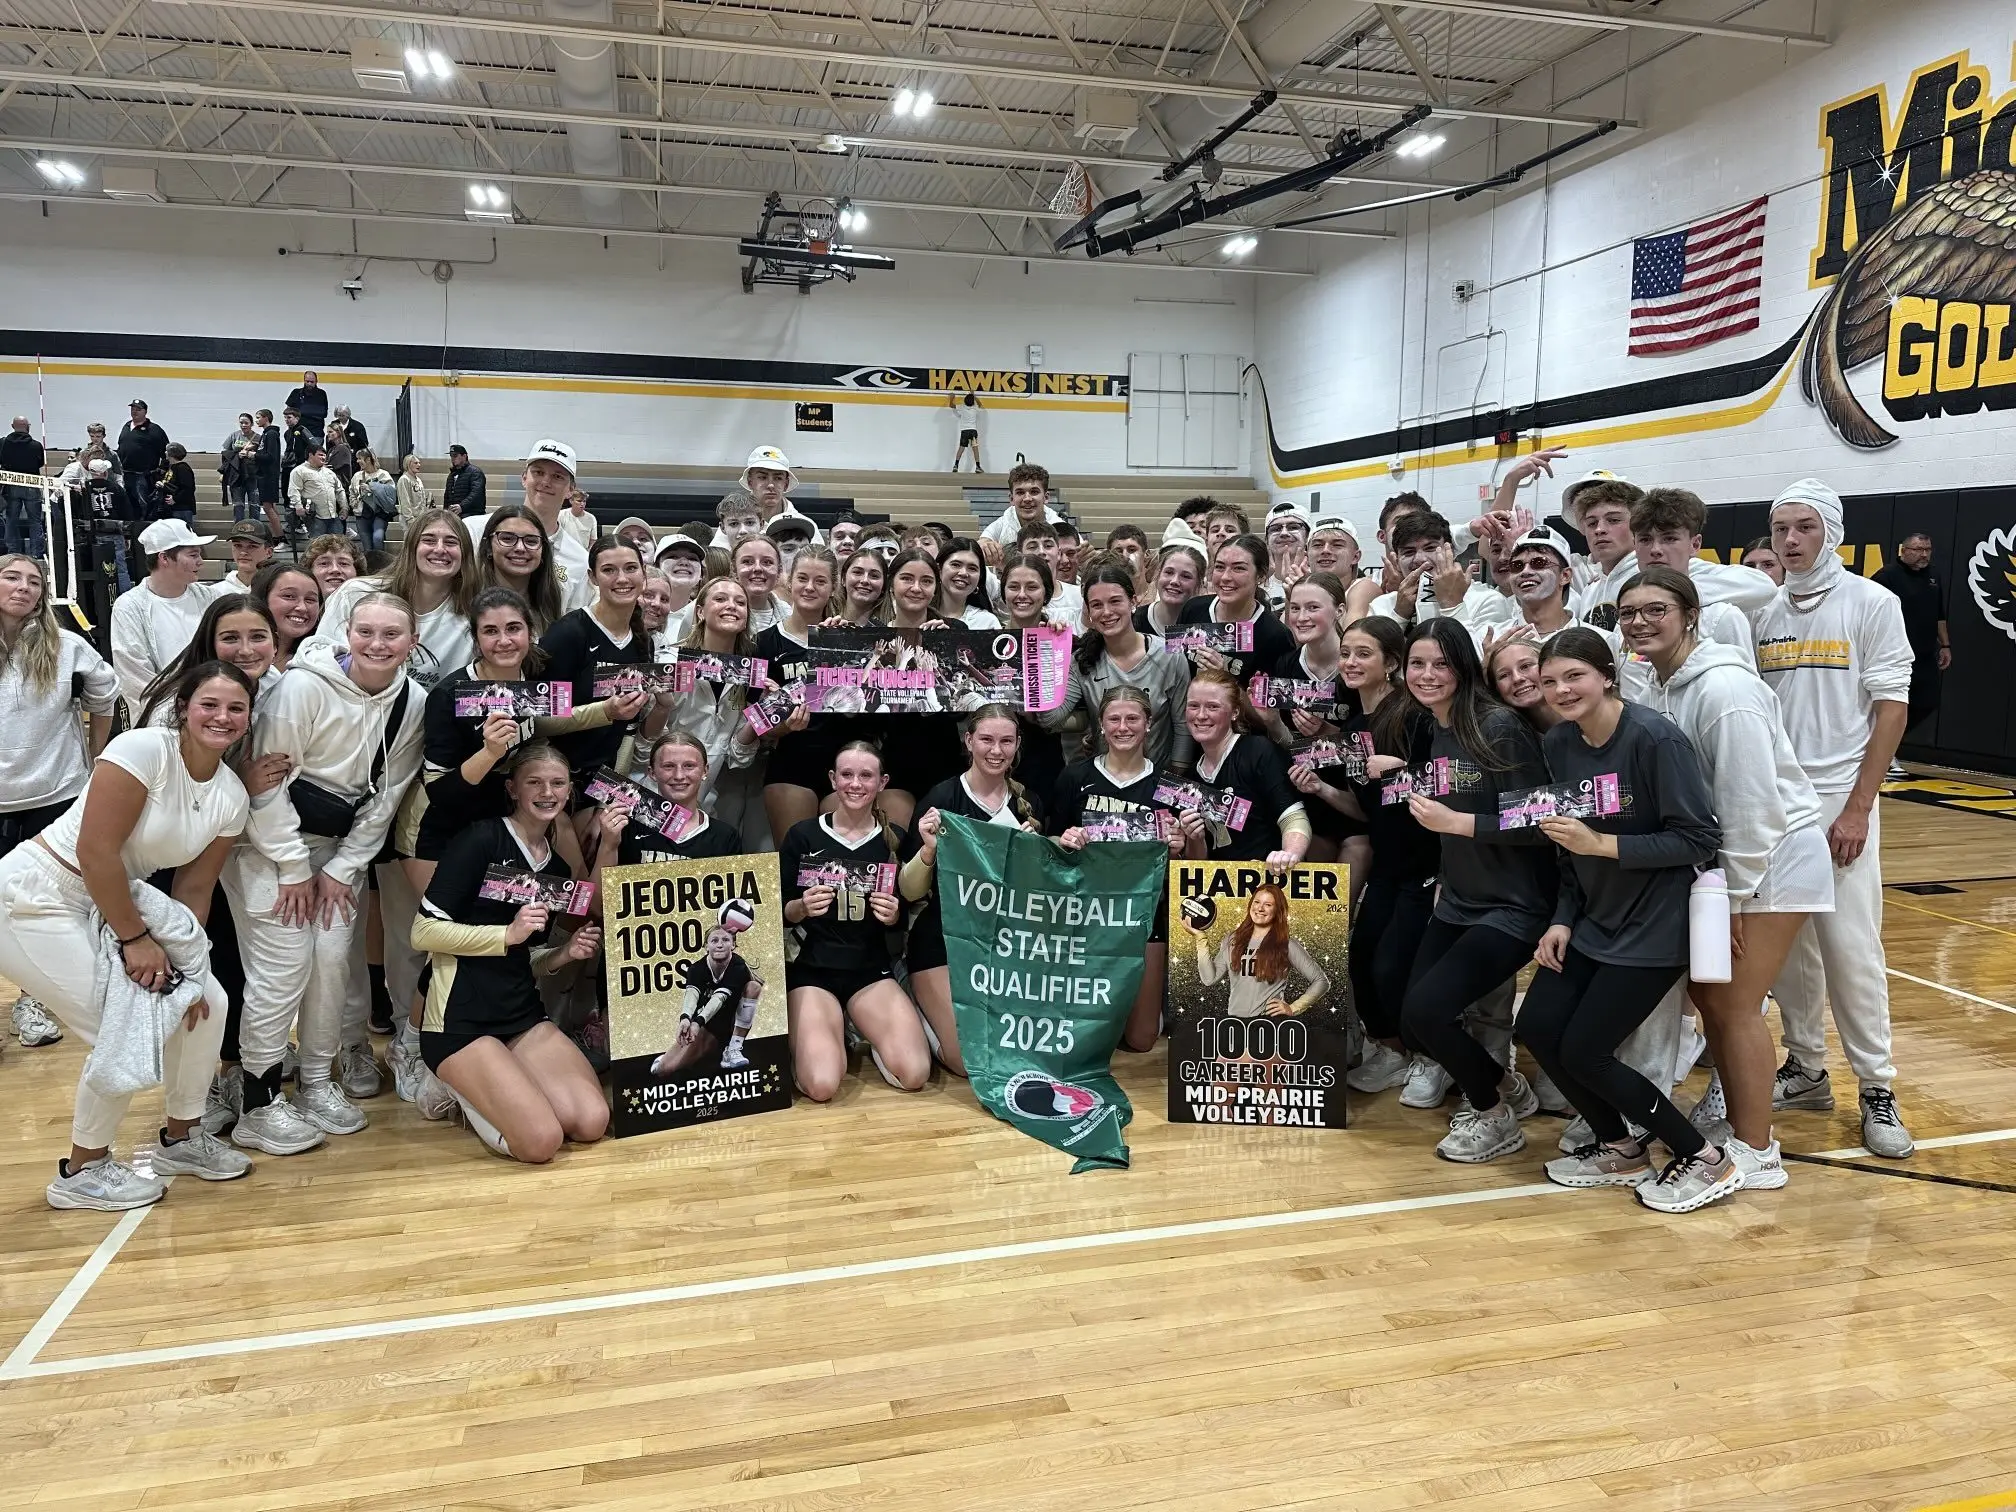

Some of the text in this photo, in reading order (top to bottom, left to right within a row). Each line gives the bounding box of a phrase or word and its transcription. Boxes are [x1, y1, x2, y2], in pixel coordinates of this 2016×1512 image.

[928, 369, 1109, 396] HAWKS NEST
[797, 418, 832, 427] Students
[808, 407, 821, 415] MP
[815, 667, 863, 687] TICKET
[867, 669, 935, 689] PUNCHED
[1027, 633, 1040, 709] ADMISSION TICKET
[616, 871, 762, 919] JEORGIA
[837, 890, 865, 920] 15
[957, 875, 1141, 927] VOLLEYBALL
[1326, 904, 1347, 913] 2025
[616, 919, 703, 960] 1000
[996, 928, 1087, 965] STATE
[620, 958, 689, 997] DIGS
[970, 964, 1111, 1005] QUALIFIER
[999, 1013, 1075, 1053] 2025
[1197, 1017, 1307, 1063] 1000
[643, 1070, 760, 1100] MID-PRAIRIE
[1180, 1060, 1335, 1088] CAREER KILLS
[645, 1085, 761, 1115] VOLLEYBALL
[1185, 1085, 1325, 1107] MID-PRAIRIE
[696, 1106, 718, 1118] 2025
[1192, 1104, 1326, 1126] VOLLEYBALL
[1760, 1161, 1780, 1170] HOKA
